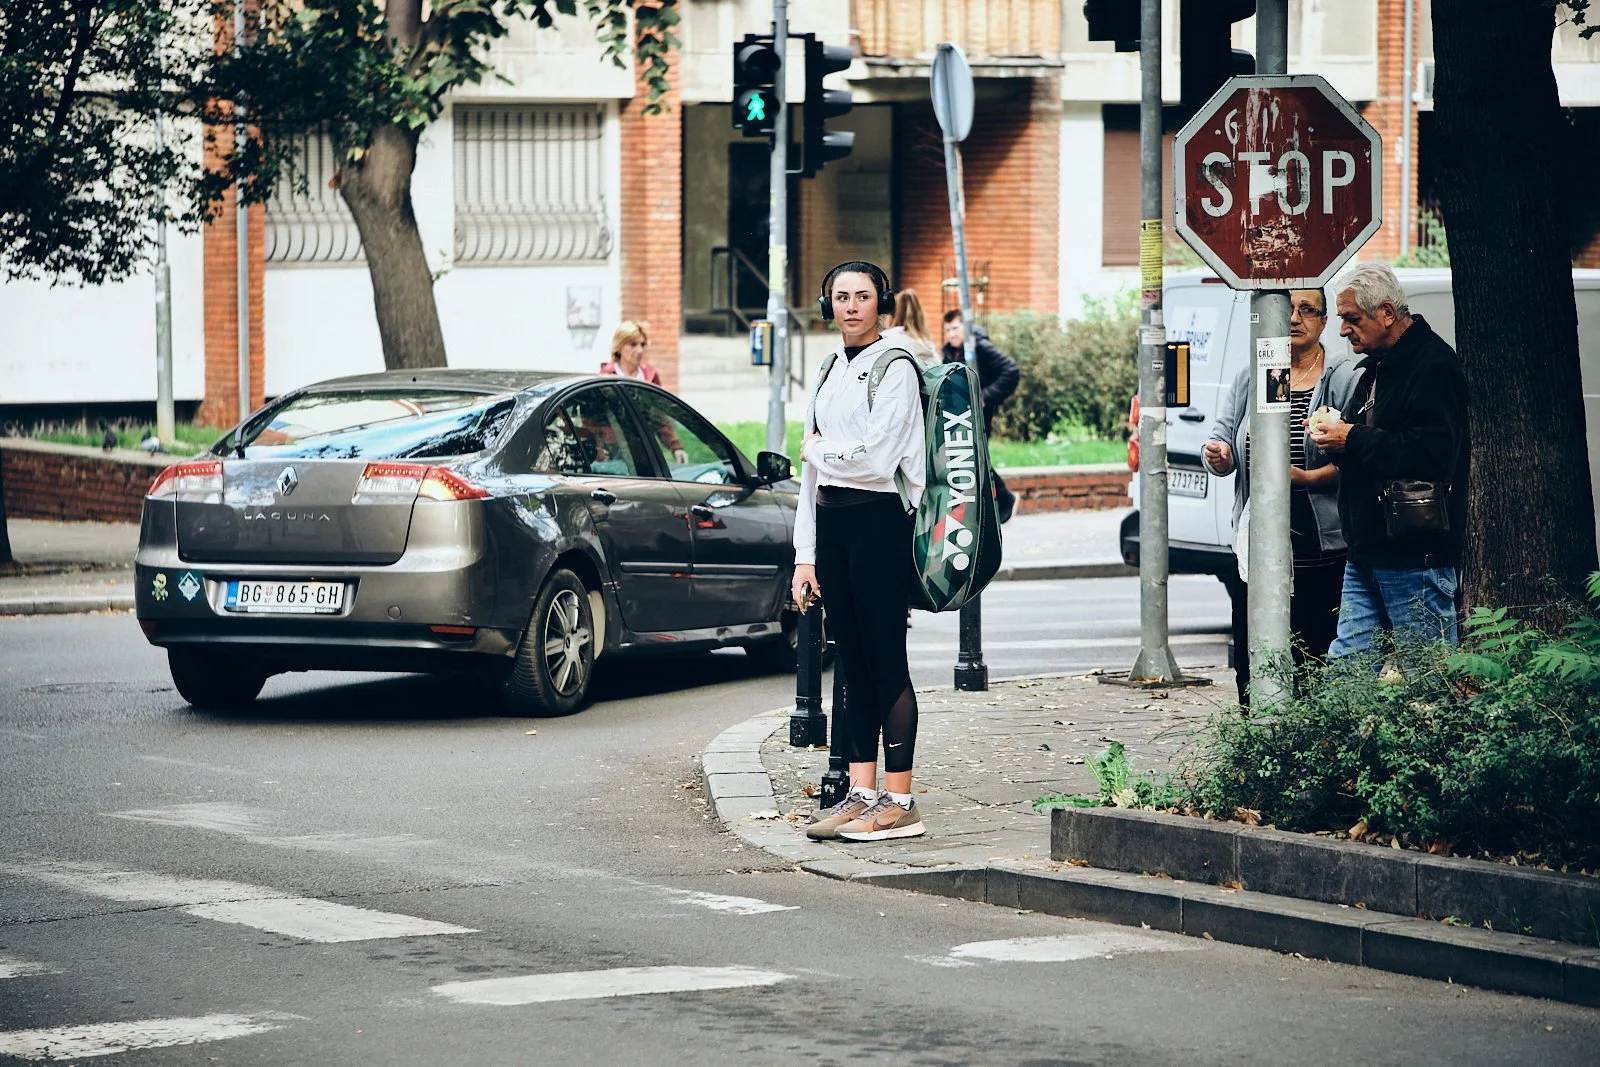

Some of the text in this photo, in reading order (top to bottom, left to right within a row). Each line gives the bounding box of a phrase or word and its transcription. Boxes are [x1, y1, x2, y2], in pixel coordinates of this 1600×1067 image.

[1201, 150, 1356, 218] STOP
[942, 408, 977, 508] YONEX
[244, 511, 331, 521] LAGUNA
[240, 584, 262, 603] BG
